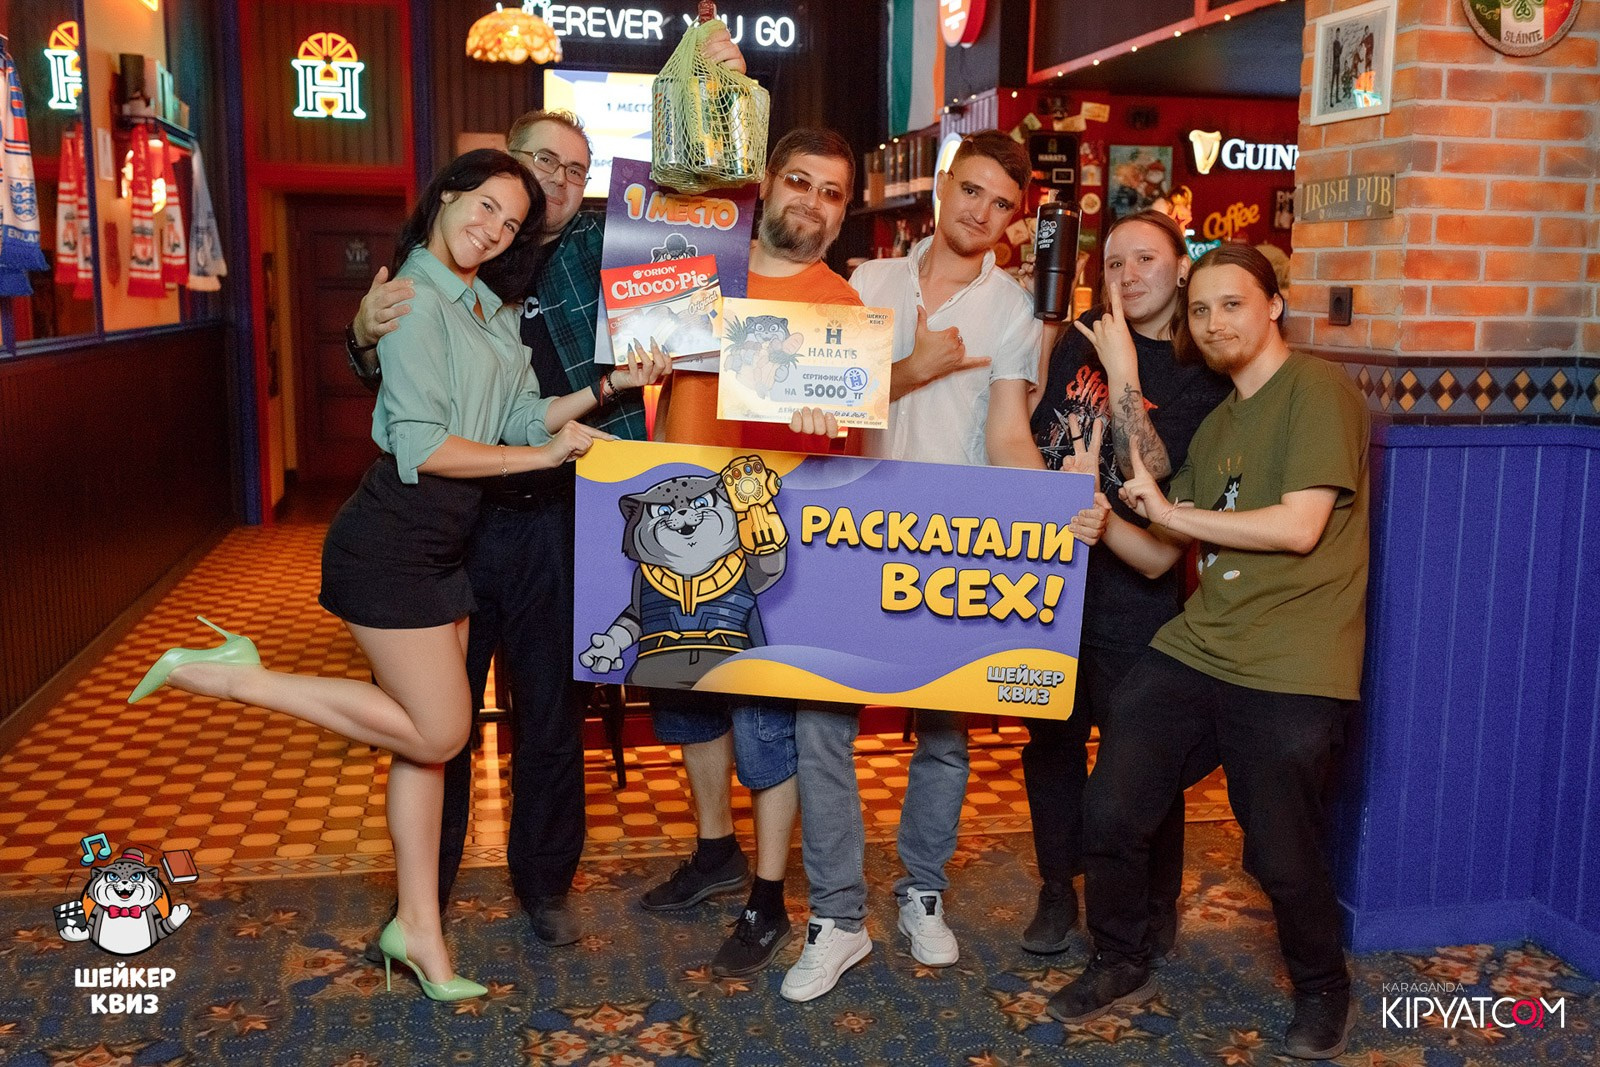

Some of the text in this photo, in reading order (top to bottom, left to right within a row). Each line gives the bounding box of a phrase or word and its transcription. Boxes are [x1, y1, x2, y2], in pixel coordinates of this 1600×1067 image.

[496, 2, 663, 40] EREVER
[755, 15, 796, 48] GO
[624, 183, 739, 231] 1 МЕСТО
[1304, 176, 1392, 215] IRISH PUB
[1203, 202, 1260, 240] Coffee
[643, 265, 677, 278] ORION
[688, 290, 719, 315] Original
[784, 384, 864, 400] НА 5000 ТГ
[801, 504, 1075, 563] РАСКАТАЛИ
[881, 562, 1065, 624] ВСЕХ!
[987, 664, 1065, 687] ШЕЙКЕР
[998, 685, 1050, 705] КВИЗ
